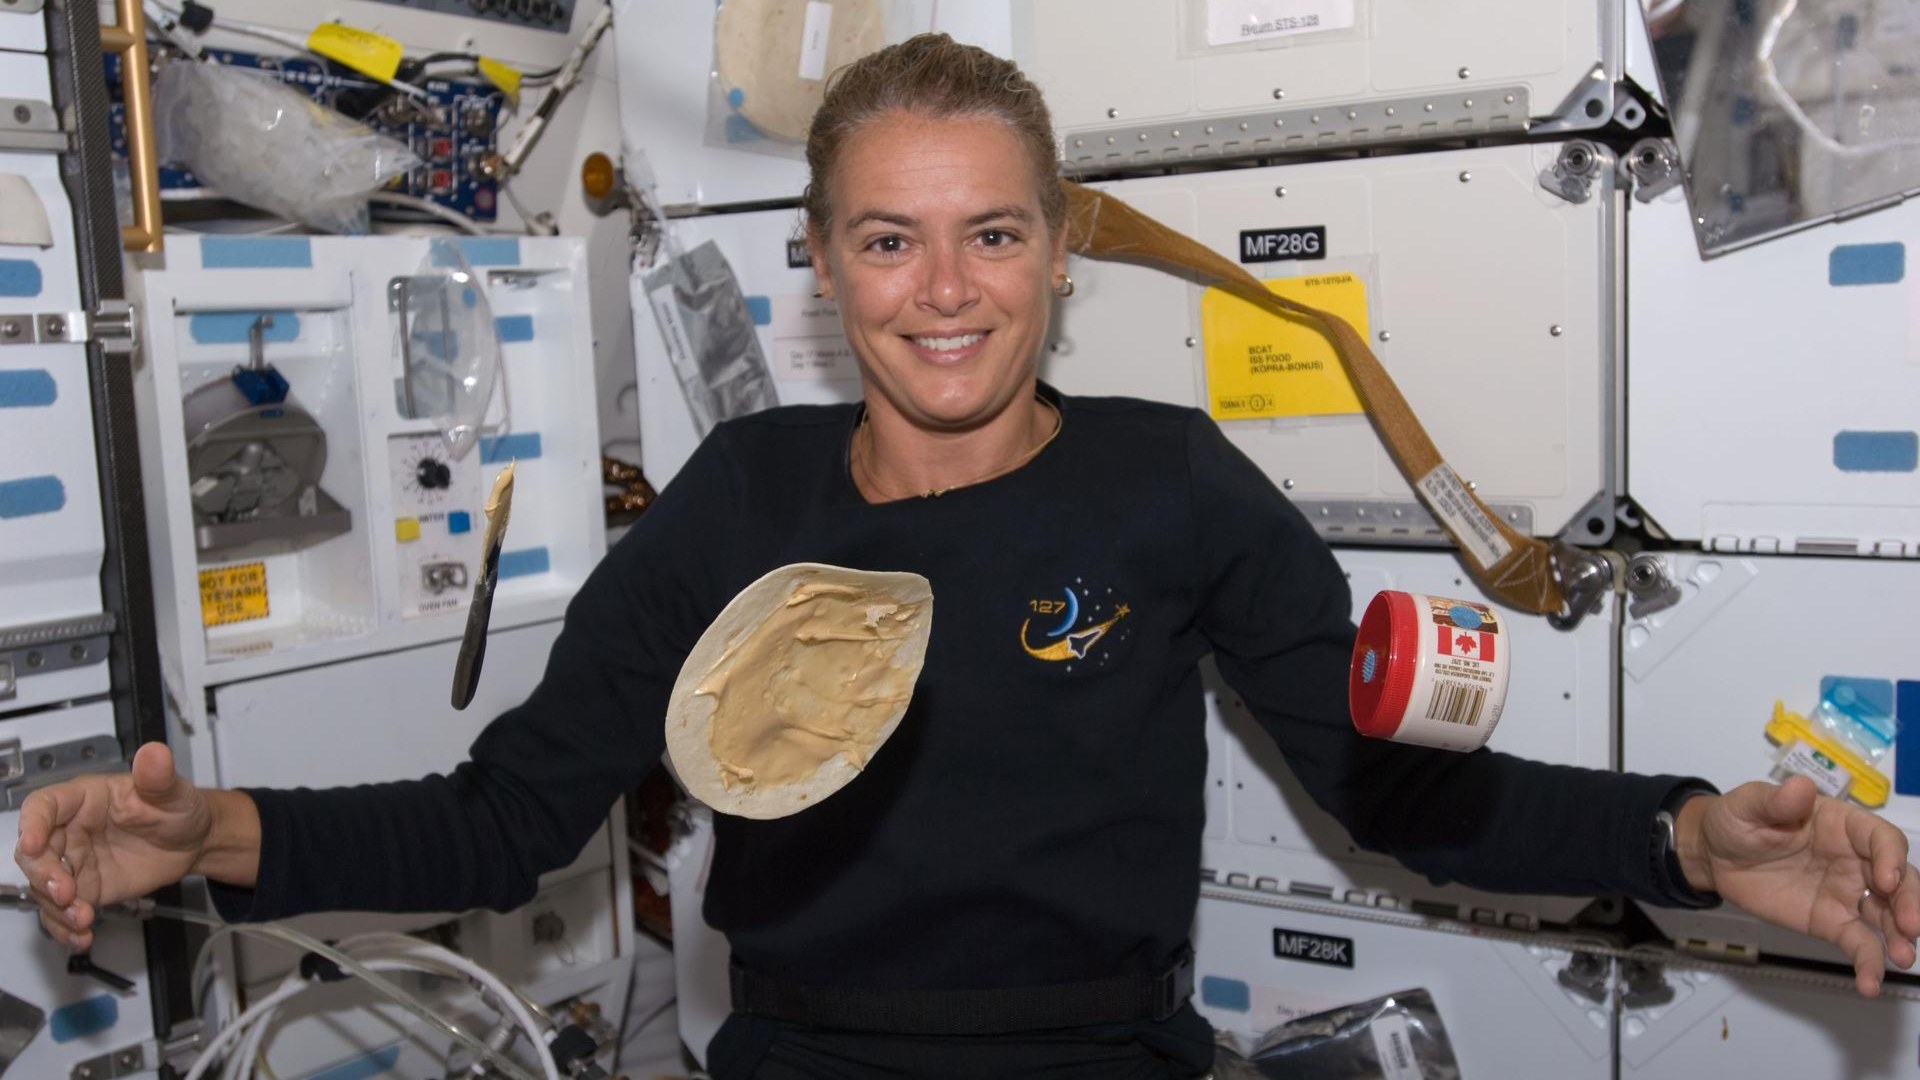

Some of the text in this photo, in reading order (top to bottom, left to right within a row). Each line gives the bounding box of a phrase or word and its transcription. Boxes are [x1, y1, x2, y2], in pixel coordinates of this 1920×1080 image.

[1245, 231, 1320, 257] MF28G
[1249, 345, 1273, 355] BCAT
[1249, 353, 1292, 364] ISS FOOD
[1250, 361, 1324, 375] (KOPRA-BONUS)
[230, 571, 258, 585] FOR
[203, 586, 263, 604] YEWASH
[217, 601, 243, 617] USE
[1029, 599, 1066, 614] 127
[1279, 934, 1348, 963] MF28K
